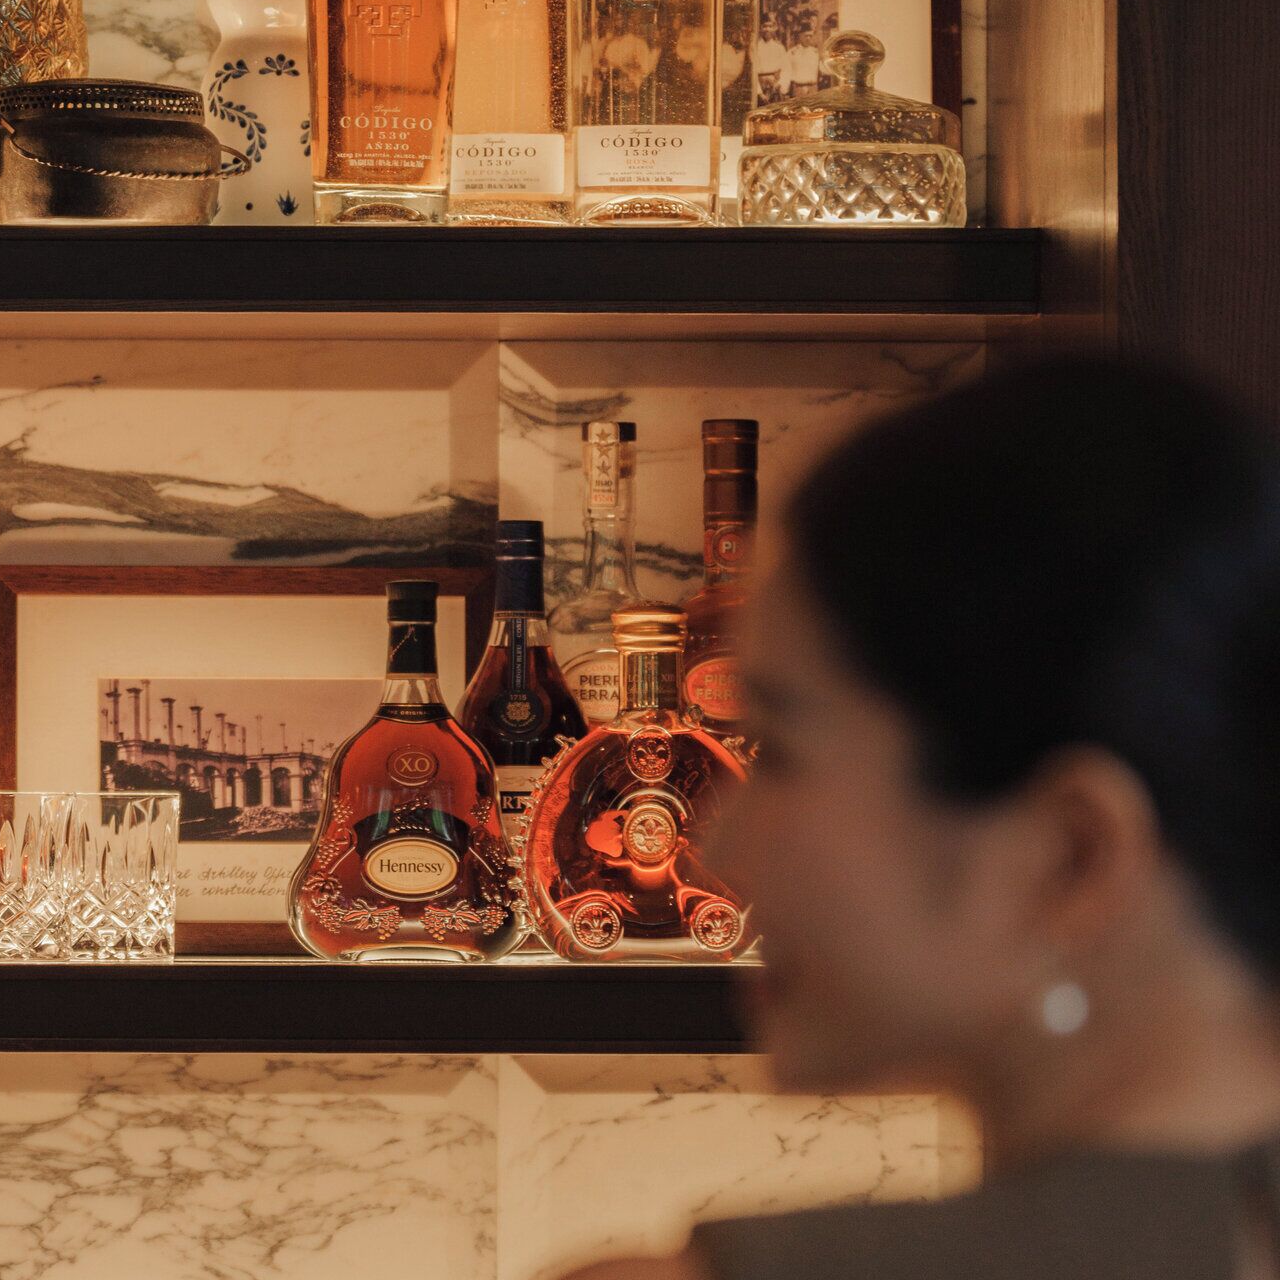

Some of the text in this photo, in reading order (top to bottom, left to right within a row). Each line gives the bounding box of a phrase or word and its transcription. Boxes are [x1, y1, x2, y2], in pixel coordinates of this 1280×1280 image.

[339, 112, 433, 131] CÓDIGO
[365, 141, 410, 150] AÑEJO
[600, 134, 683, 148] CÓDIGO
[456, 144, 537, 158] CÓDIGO
[379, 858, 446, 876] Hennessy
